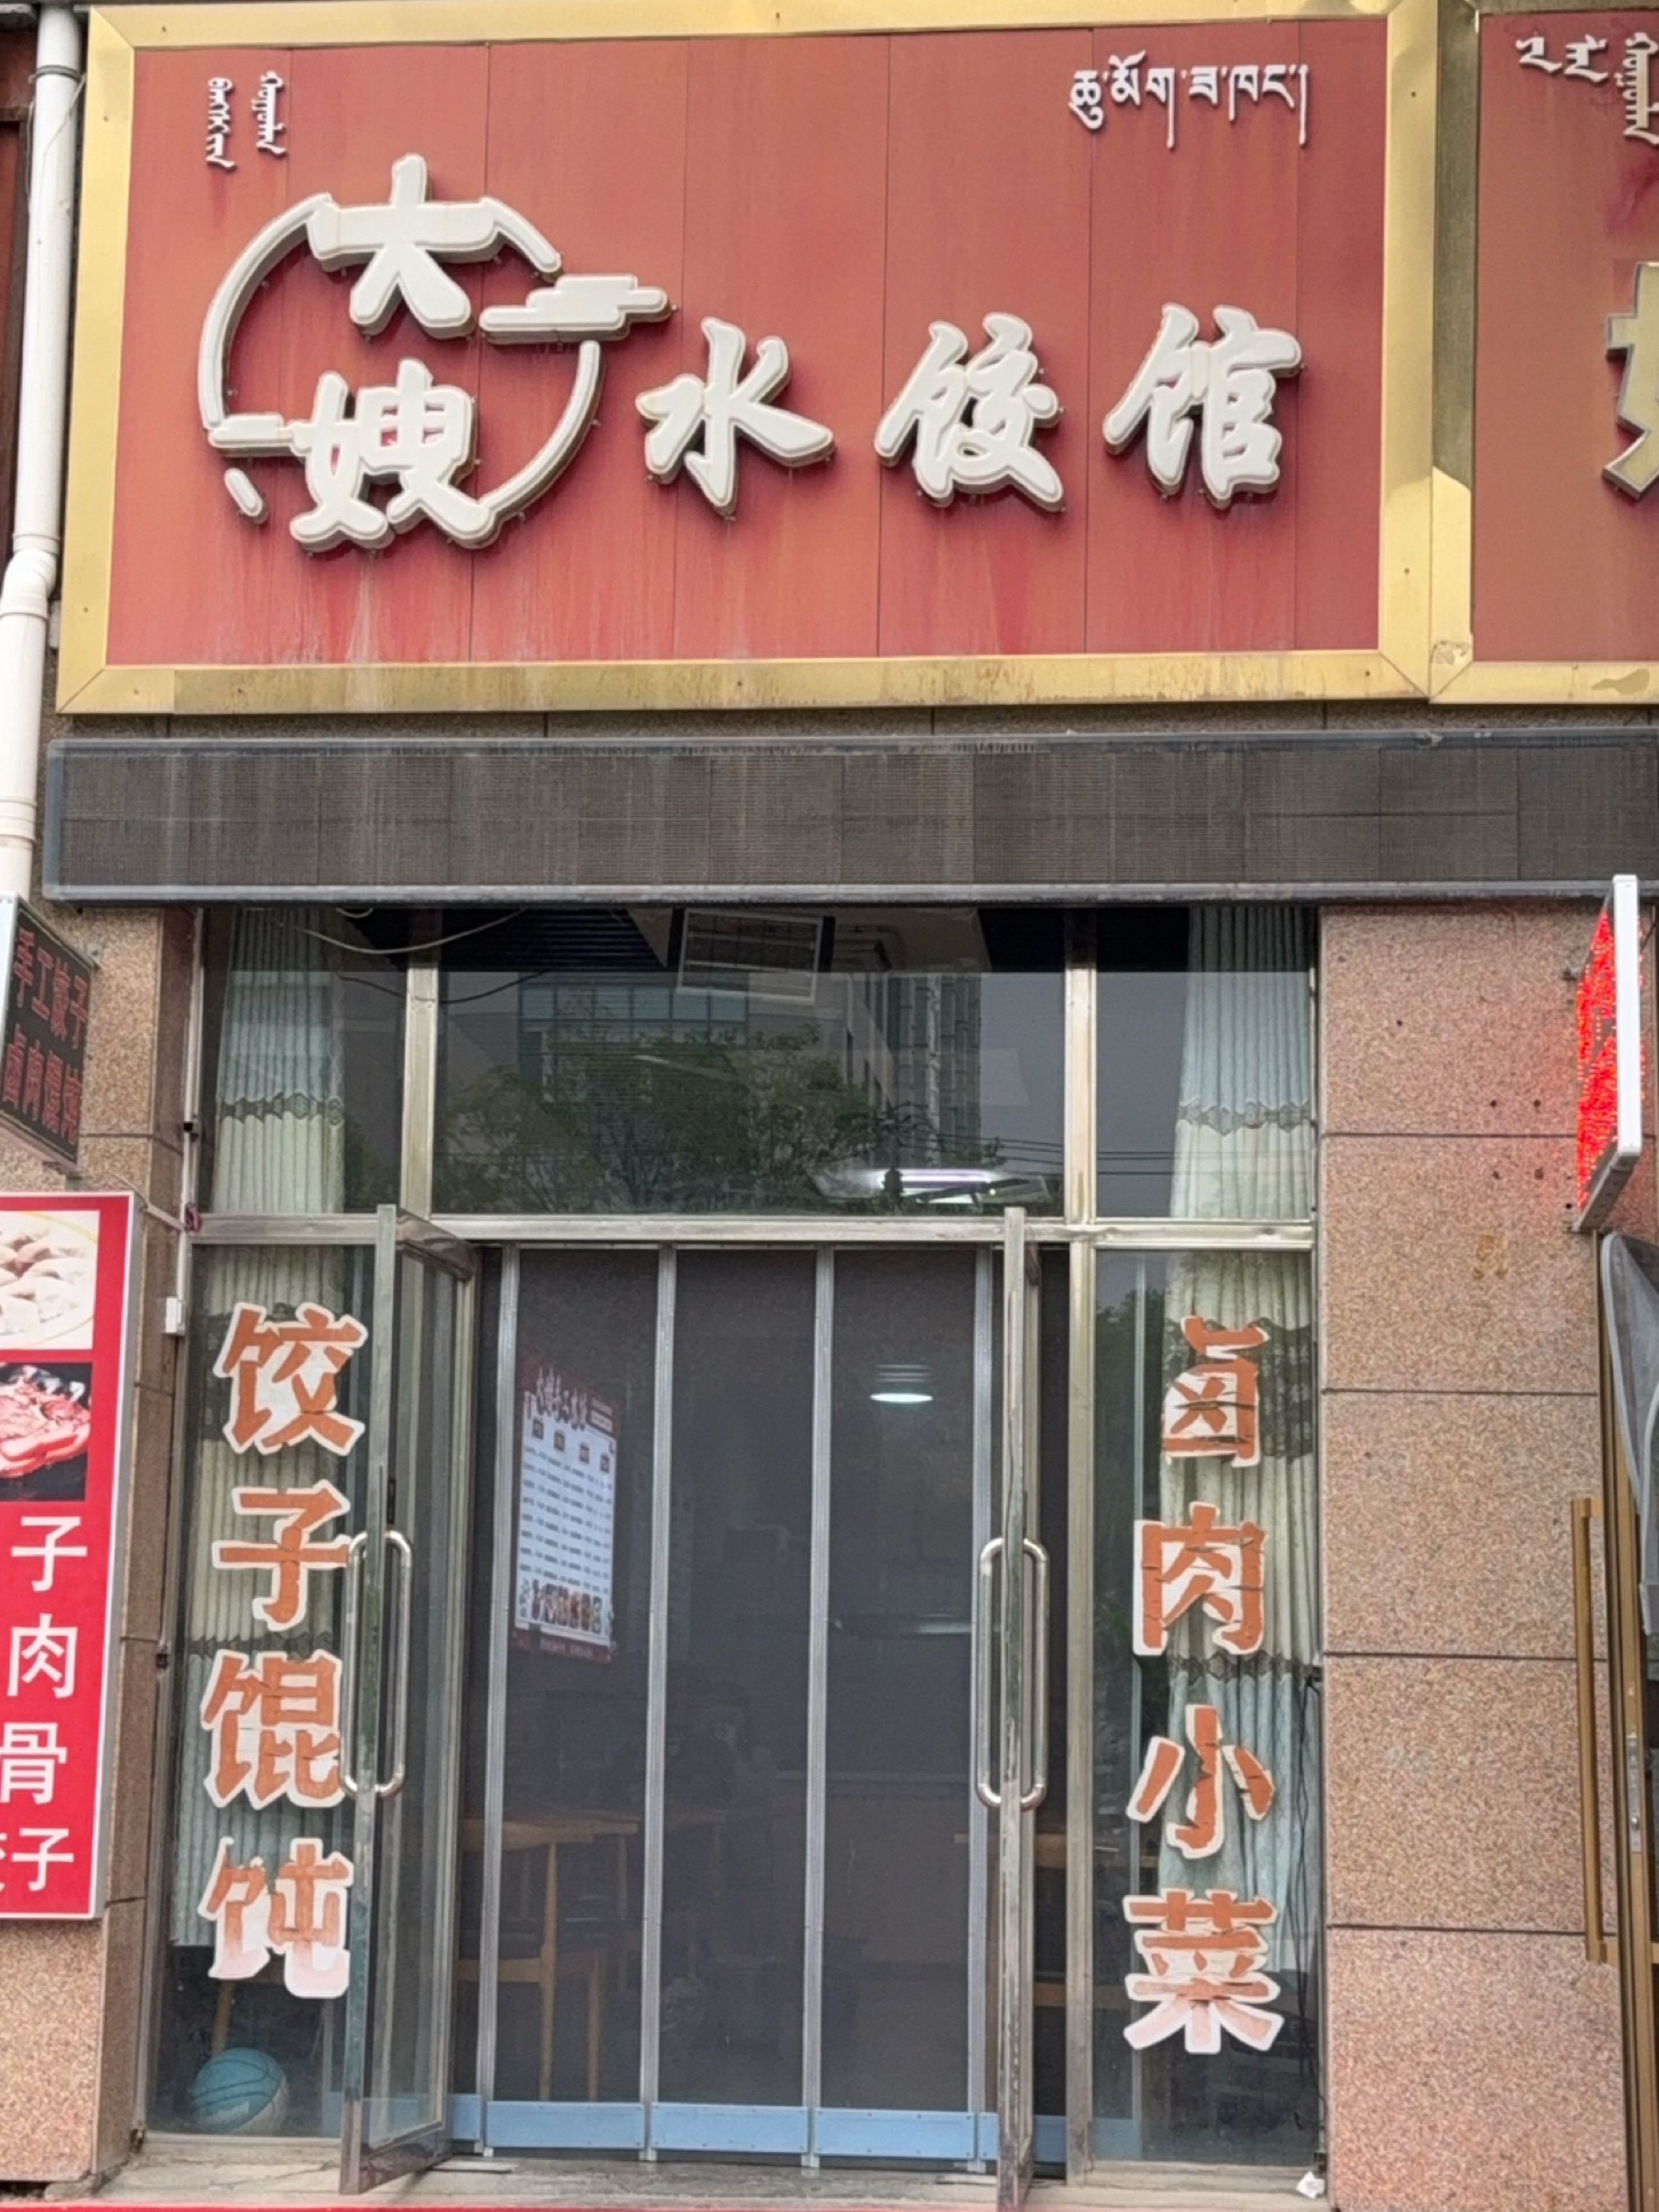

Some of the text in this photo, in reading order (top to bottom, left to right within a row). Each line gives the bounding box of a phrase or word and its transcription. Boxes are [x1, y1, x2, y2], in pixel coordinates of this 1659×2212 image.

[636, 302, 1302, 516] 水饺馆
[13, 927, 88, 1050] 手工饺子
[198, 1302, 368, 1998] 饺子馄饨
[1123, 1314, 1285, 2054] 卤肉小菜
